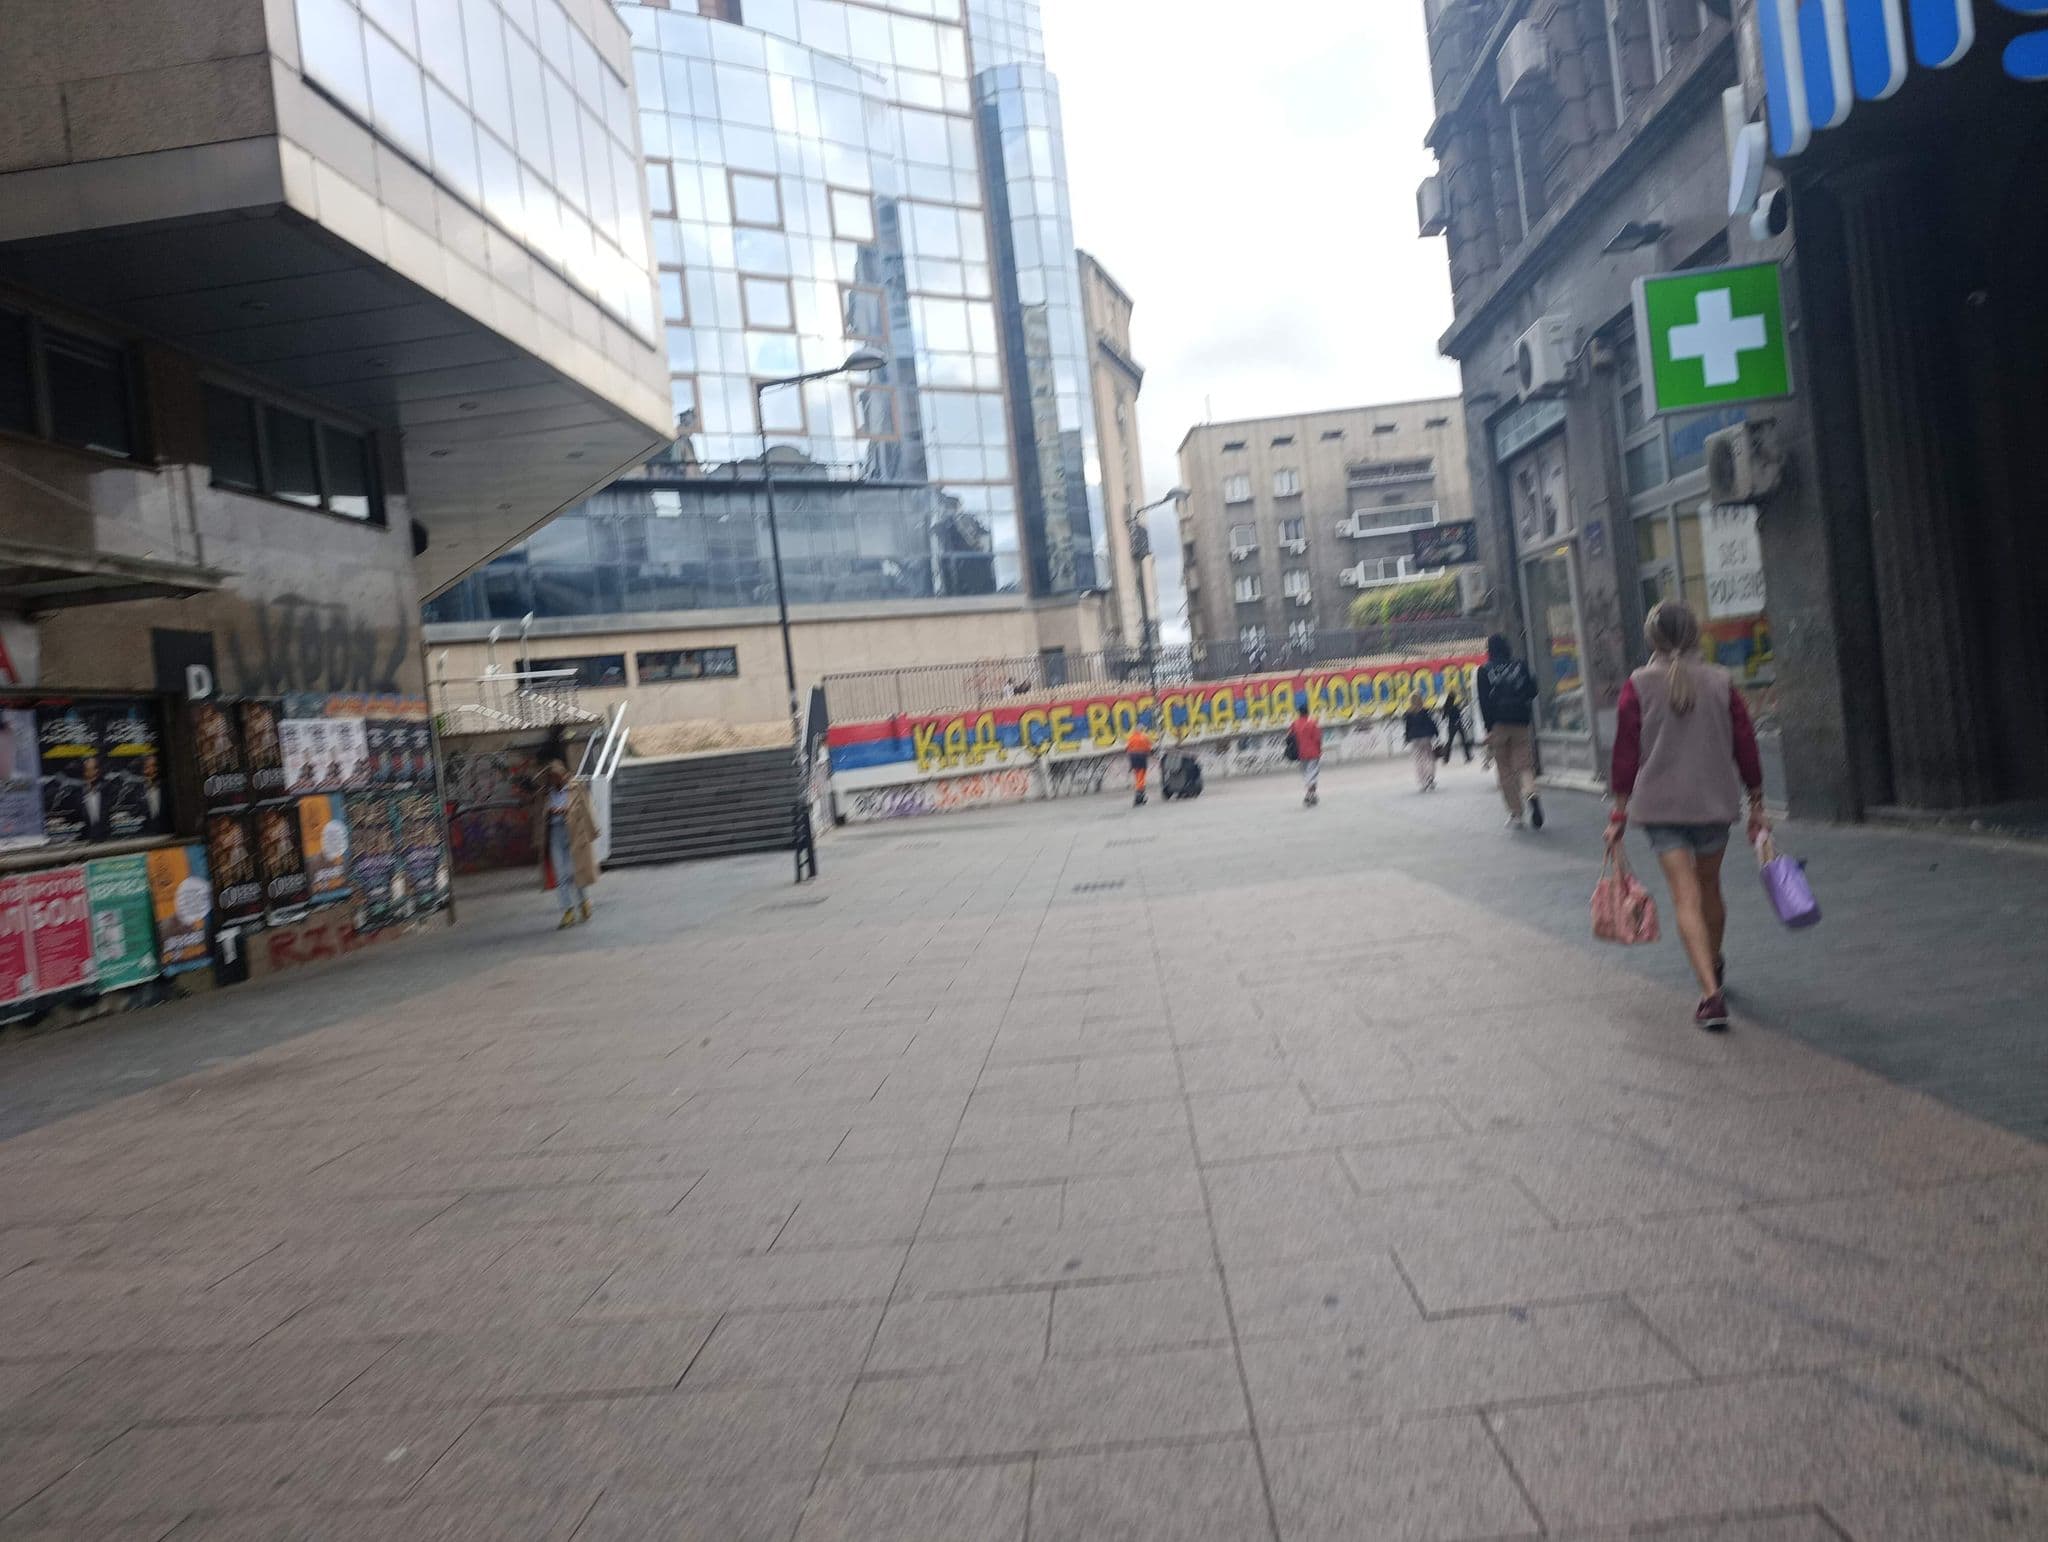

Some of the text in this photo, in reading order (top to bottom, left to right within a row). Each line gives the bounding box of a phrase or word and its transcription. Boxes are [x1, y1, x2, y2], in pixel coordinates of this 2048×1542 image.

[1019, 703, 1080, 758] СЕ
[1244, 679, 1298, 726] НА
[1303, 666, 1438, 719] КОСОВО
